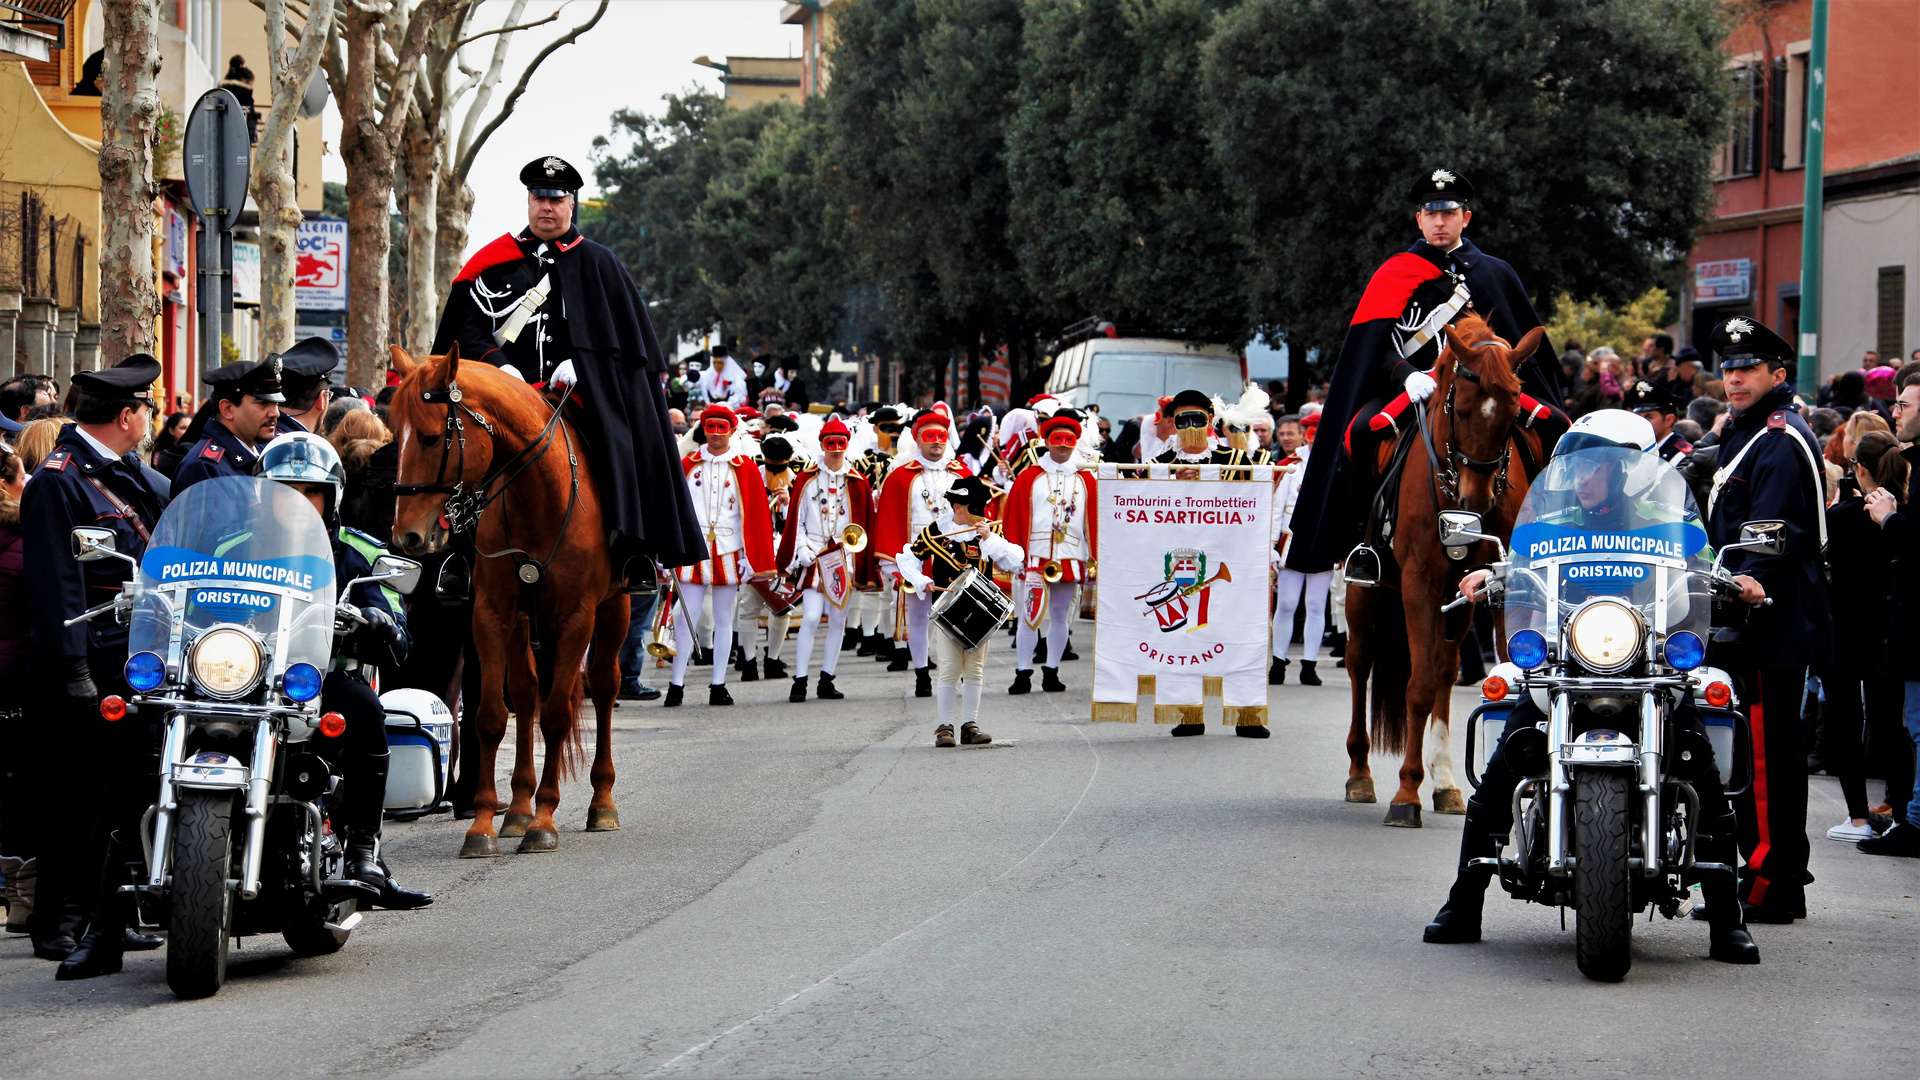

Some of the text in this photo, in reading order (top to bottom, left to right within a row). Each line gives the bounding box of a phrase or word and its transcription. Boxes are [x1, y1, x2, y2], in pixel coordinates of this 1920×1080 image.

[298, 223, 343, 233] LLERIA
[1114, 495, 1257, 509] Tamburini e Trombettieri
[1126, 510, 1149, 523] SA
[1154, 510, 1243, 525] SARTIGLIA
[1530, 534, 1683, 558] POLIZIA MUNICIPALE
[162, 561, 313, 590] POLIZIA MUNICIPALE
[1568, 565, 1644, 578] ORISTANO
[196, 591, 271, 608] ORISTANO
[1139, 642, 1225, 666] ORISTANO
